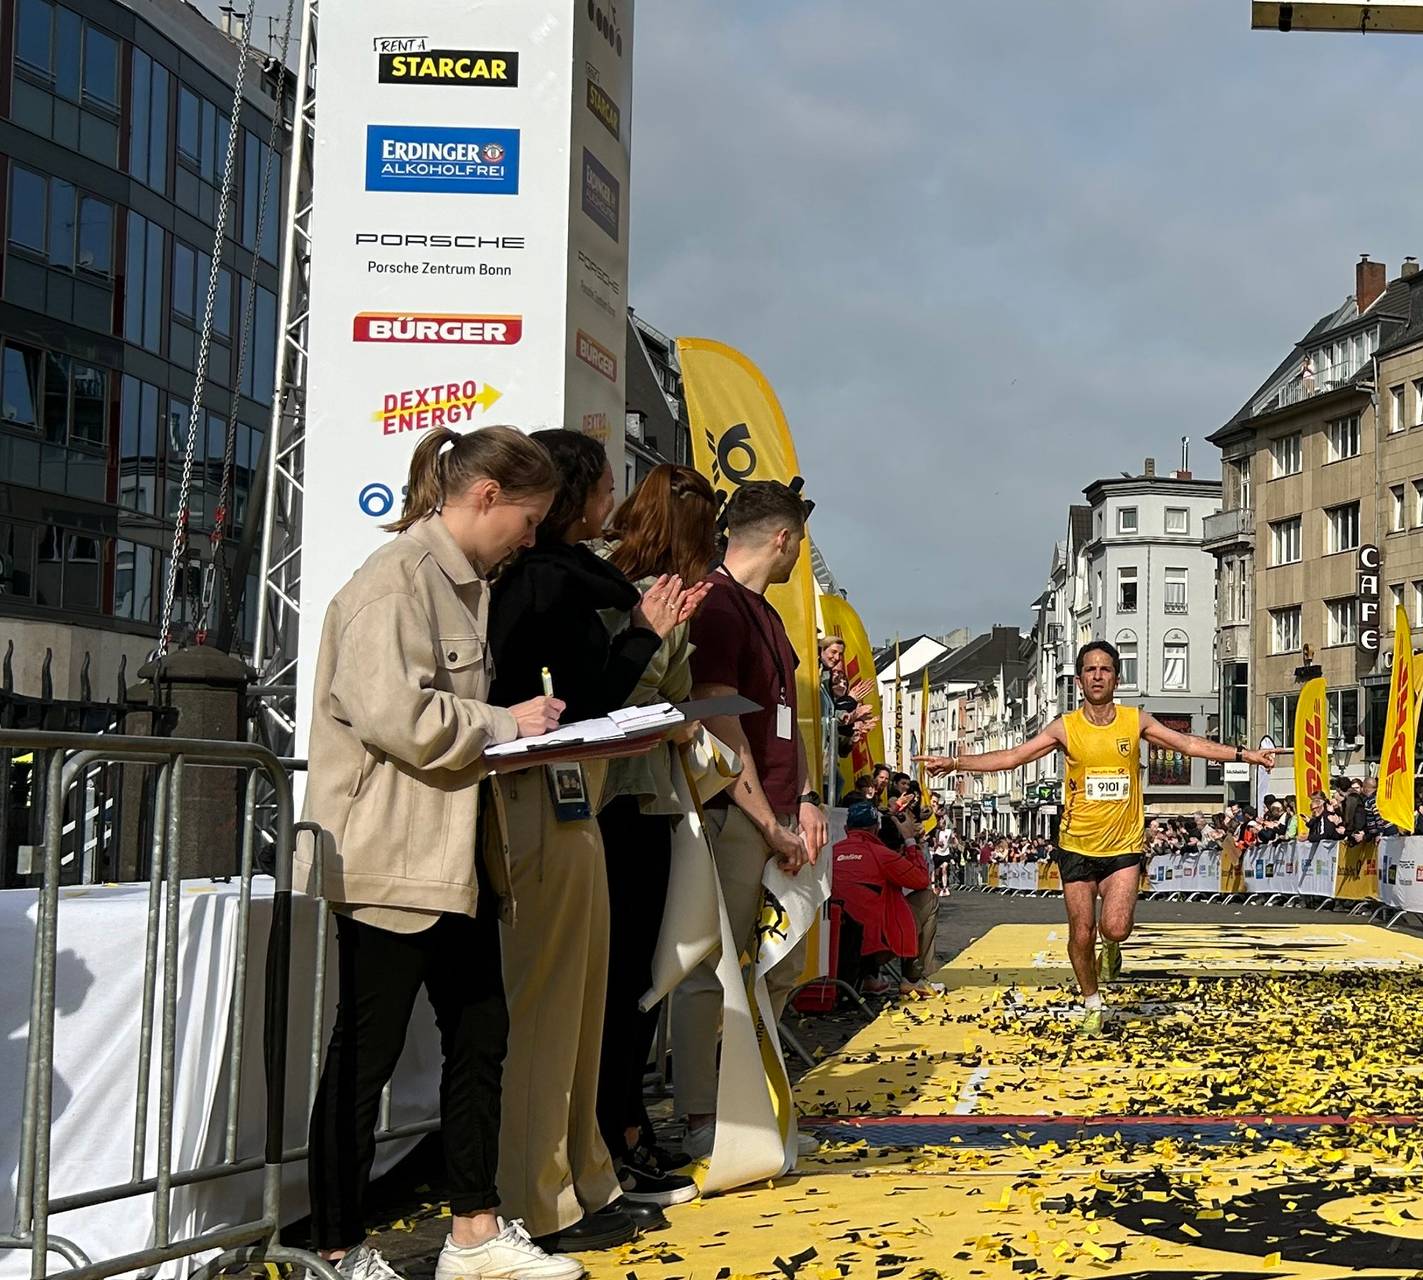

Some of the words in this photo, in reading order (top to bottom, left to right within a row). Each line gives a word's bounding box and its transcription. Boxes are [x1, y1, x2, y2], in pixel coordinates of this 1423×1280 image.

[380, 39, 417, 53] RENT
[417, 39, 426, 51] A
[391, 56, 508, 80] STARCAR
[381, 139, 482, 163] ERDINGER
[381, 163, 505, 177] ALKOHOLFREI
[355, 233, 525, 249] PORSCHE
[367, 261, 419, 274] Porsche
[422, 262, 475, 275] Zentrum
[479, 263, 512, 276] Bonn
[368, 316, 507, 342] BÜRGER
[383, 380, 477, 414] DEXTRO
[383, 401, 477, 435] ENERGY
[1361, 547, 1378, 650] CAFE
[1097, 781, 1120, 792] 9101
